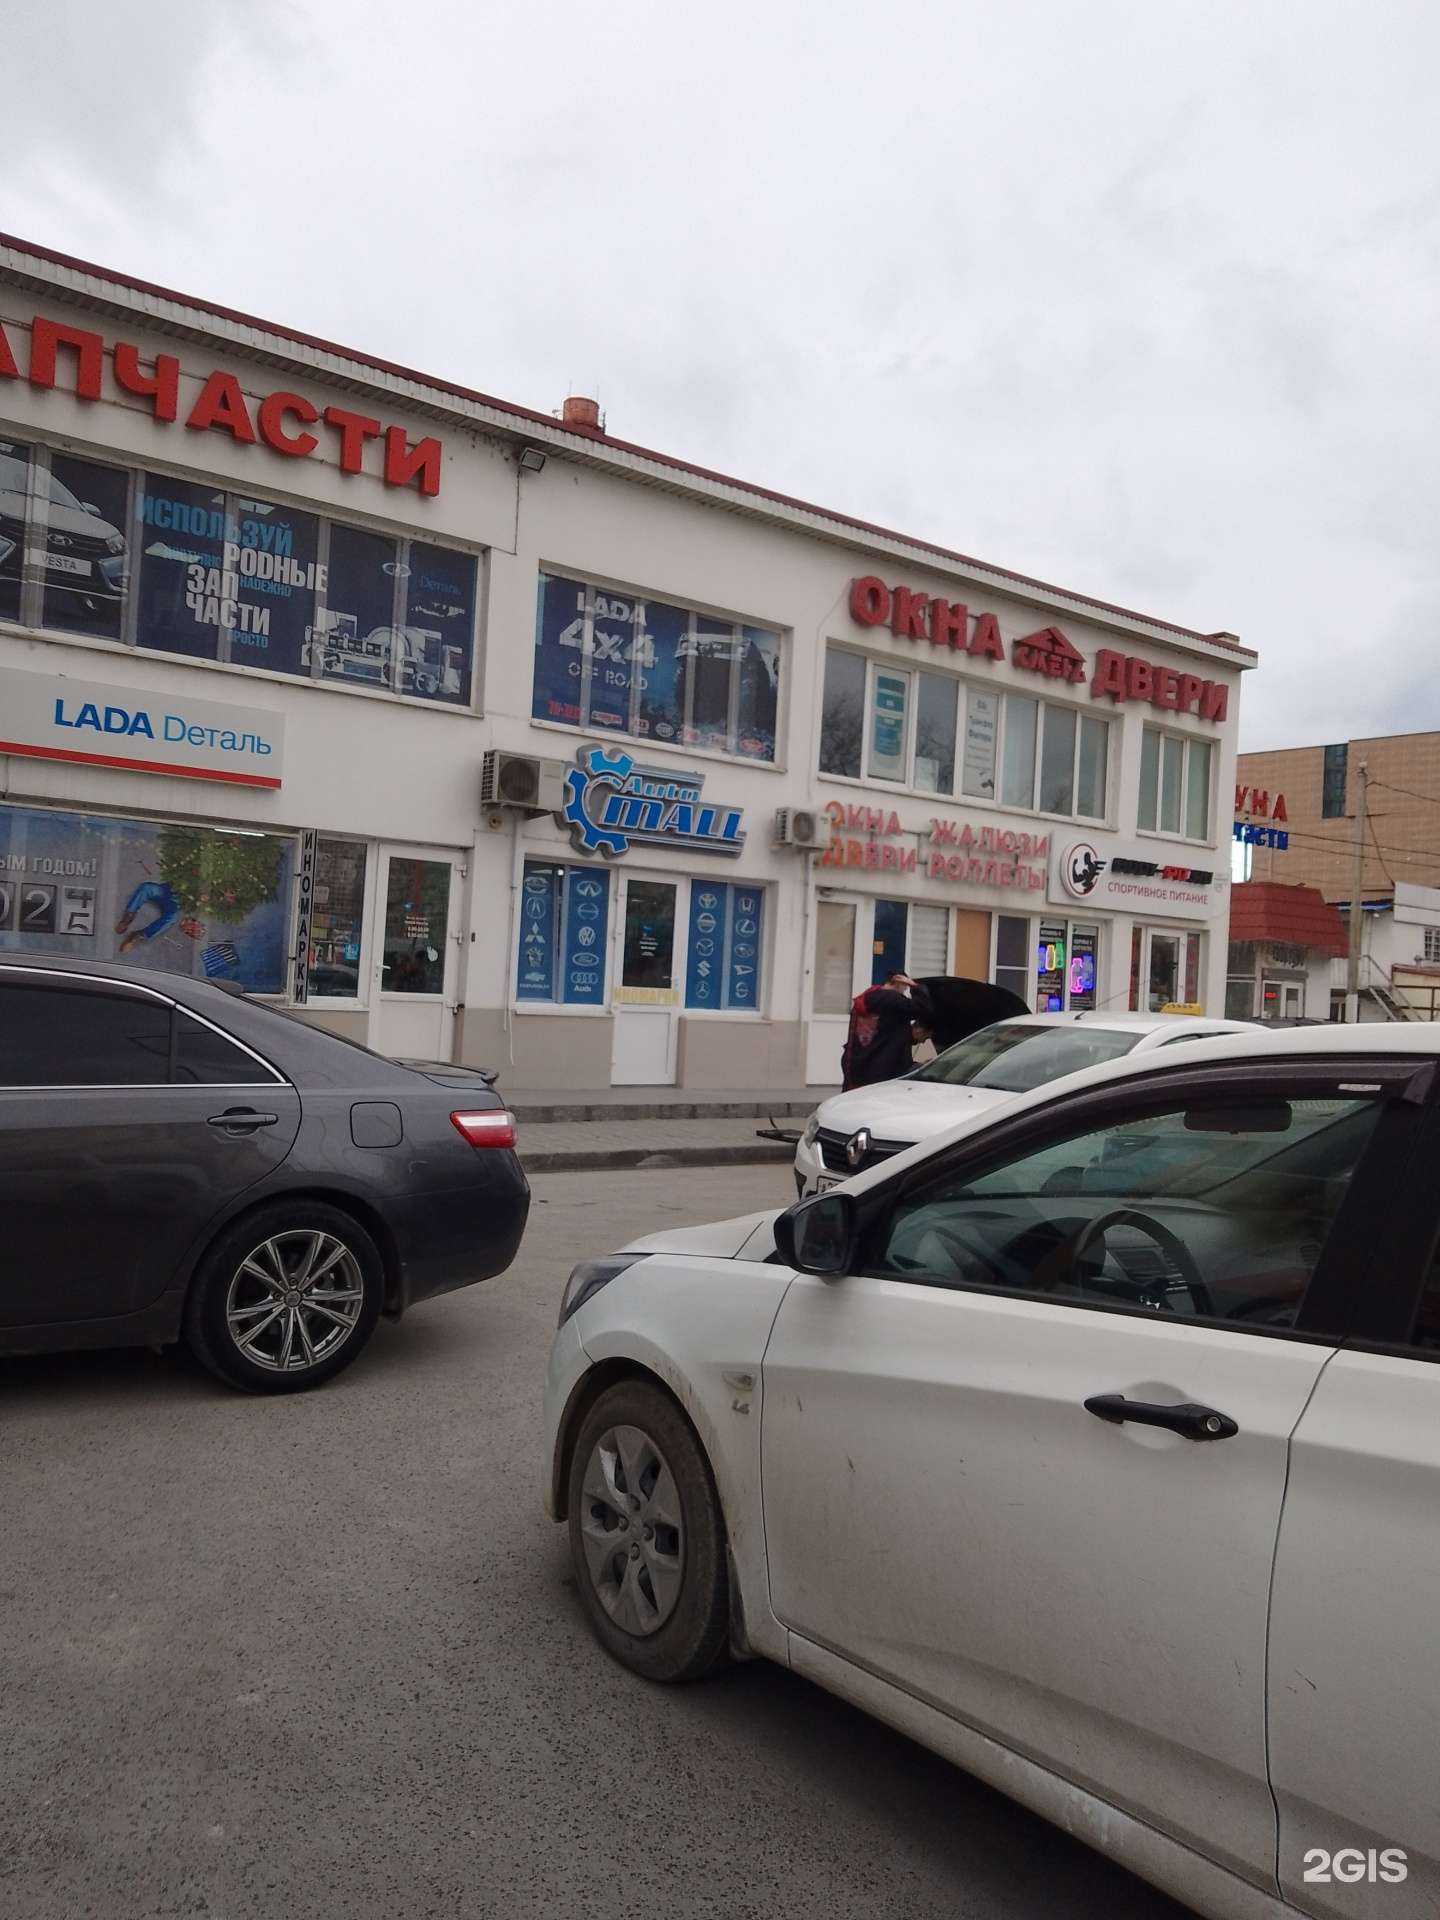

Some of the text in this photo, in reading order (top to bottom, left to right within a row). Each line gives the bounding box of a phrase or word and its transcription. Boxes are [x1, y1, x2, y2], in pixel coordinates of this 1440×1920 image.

[41, 554, 77, 570] VESTA
[186, 563, 240, 602] ЗАП
[186, 592, 272, 636] ЧАСТИ
[576, 591, 647, 627] LADA
[849, 575, 1006, 661] ОКНА
[604, 669, 648, 691] ROAD
[1091, 648, 1229, 722] ДВЕРИ
[54, 698, 154, 739] LADA
[620, 775, 702, 802] Auto
[929, 817, 1050, 857] ЖАЛЮЗИ
[32, 857, 97, 878] ГОДОМ!
[928, 852, 1047, 891] РОЛЛЕТЫ
[1107, 881, 1209, 905] СПОРТИВНОЕ ПИТАНИЕ
[295, 832, 314, 1002] ИНОМАРКИ
